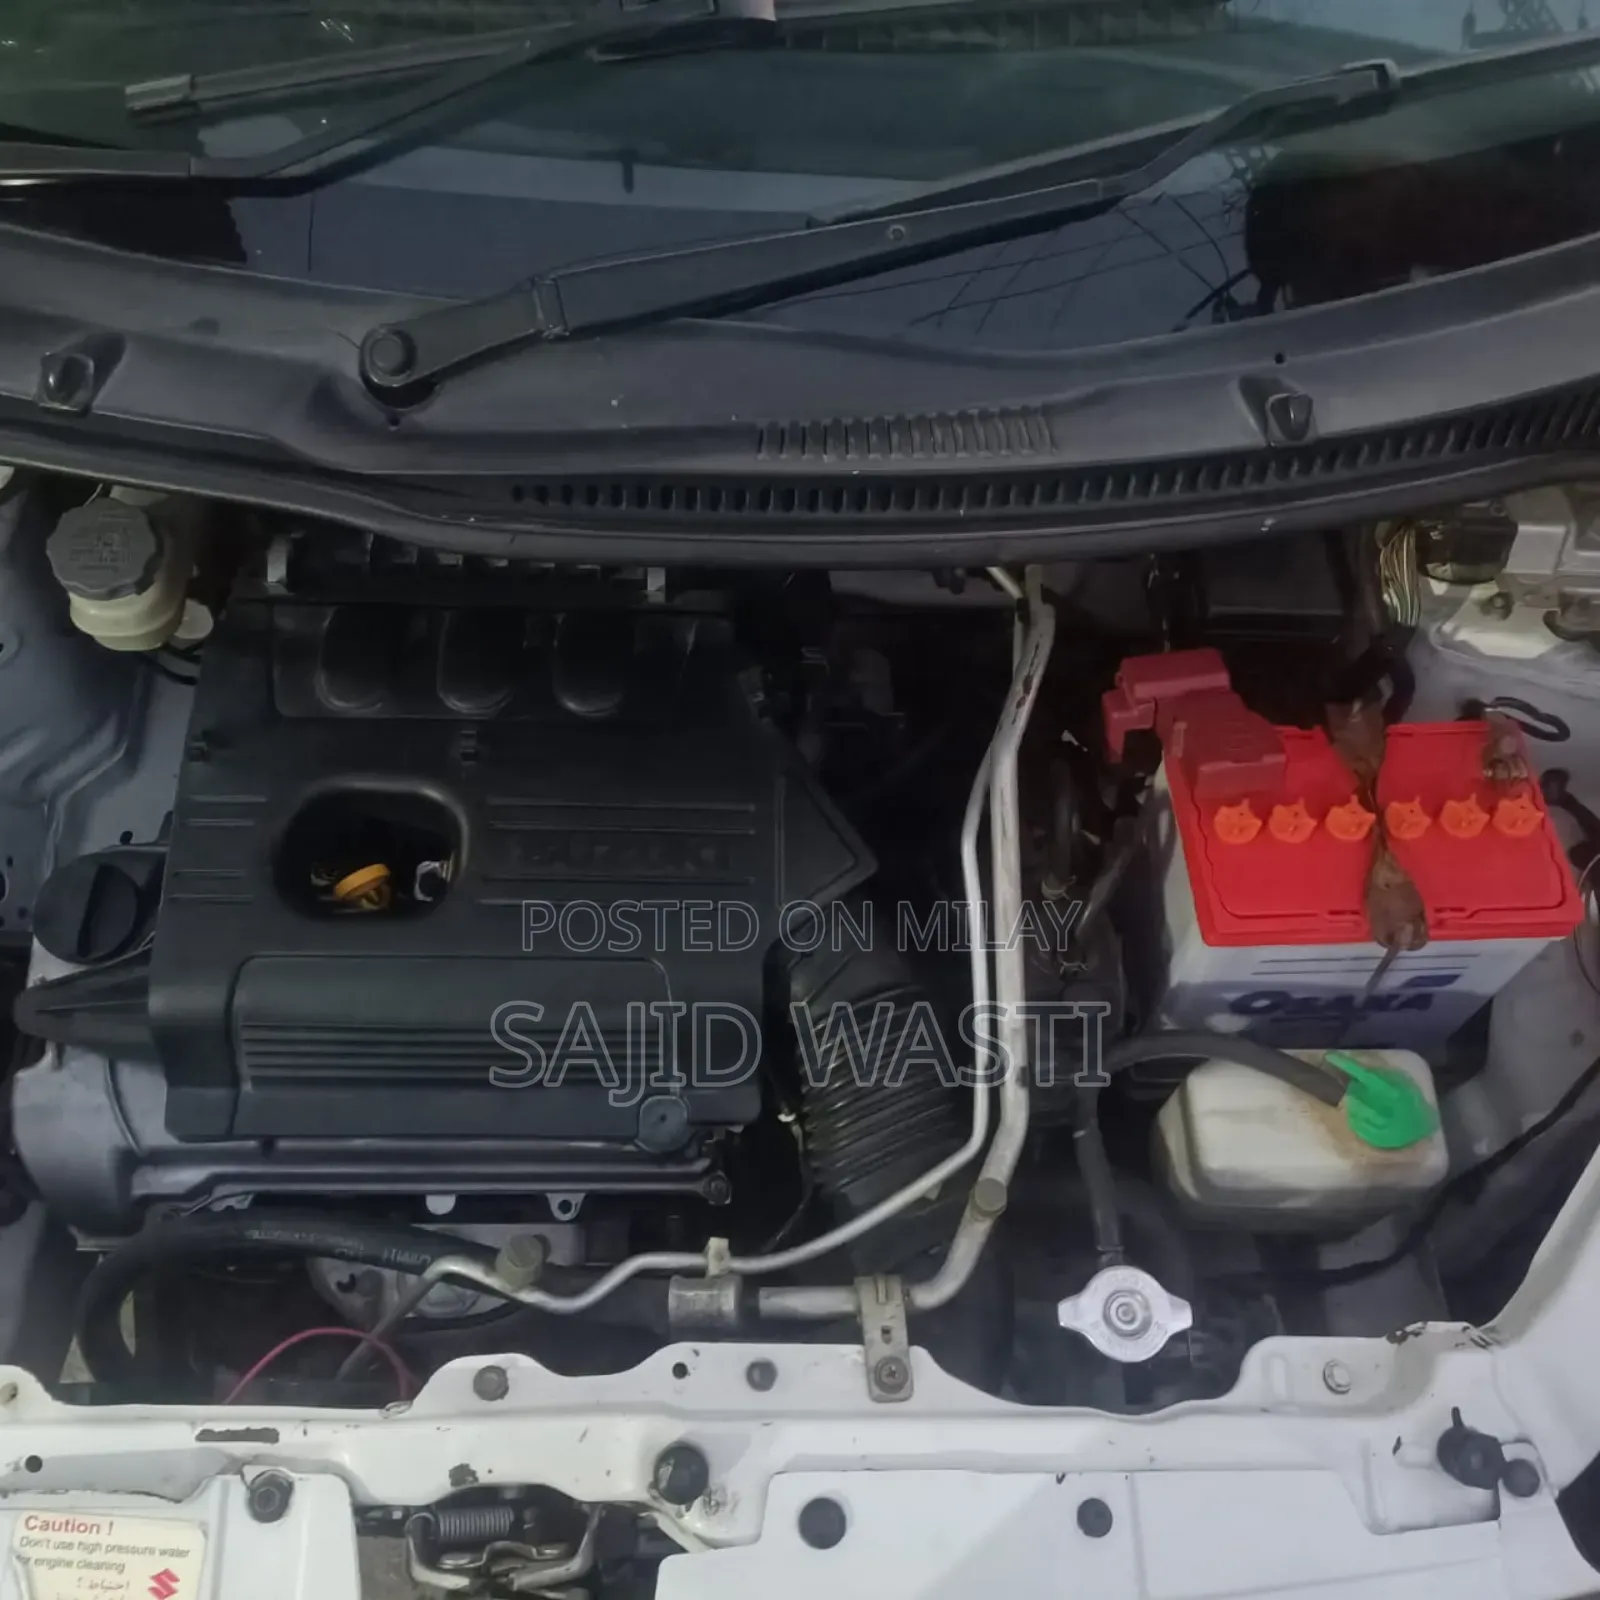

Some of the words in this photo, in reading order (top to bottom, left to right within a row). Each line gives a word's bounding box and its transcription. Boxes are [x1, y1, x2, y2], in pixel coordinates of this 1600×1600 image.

[24, 1515, 101, 1535] Caution
[53, 1540, 74, 1551] use
[77, 1540, 102, 1554] high
[104, 1543, 156, 1557] pressure
[159, 1547, 191, 1559] water
[34, 1557, 74, 1571] engine
[76, 1559, 126, 1575] cleaning
